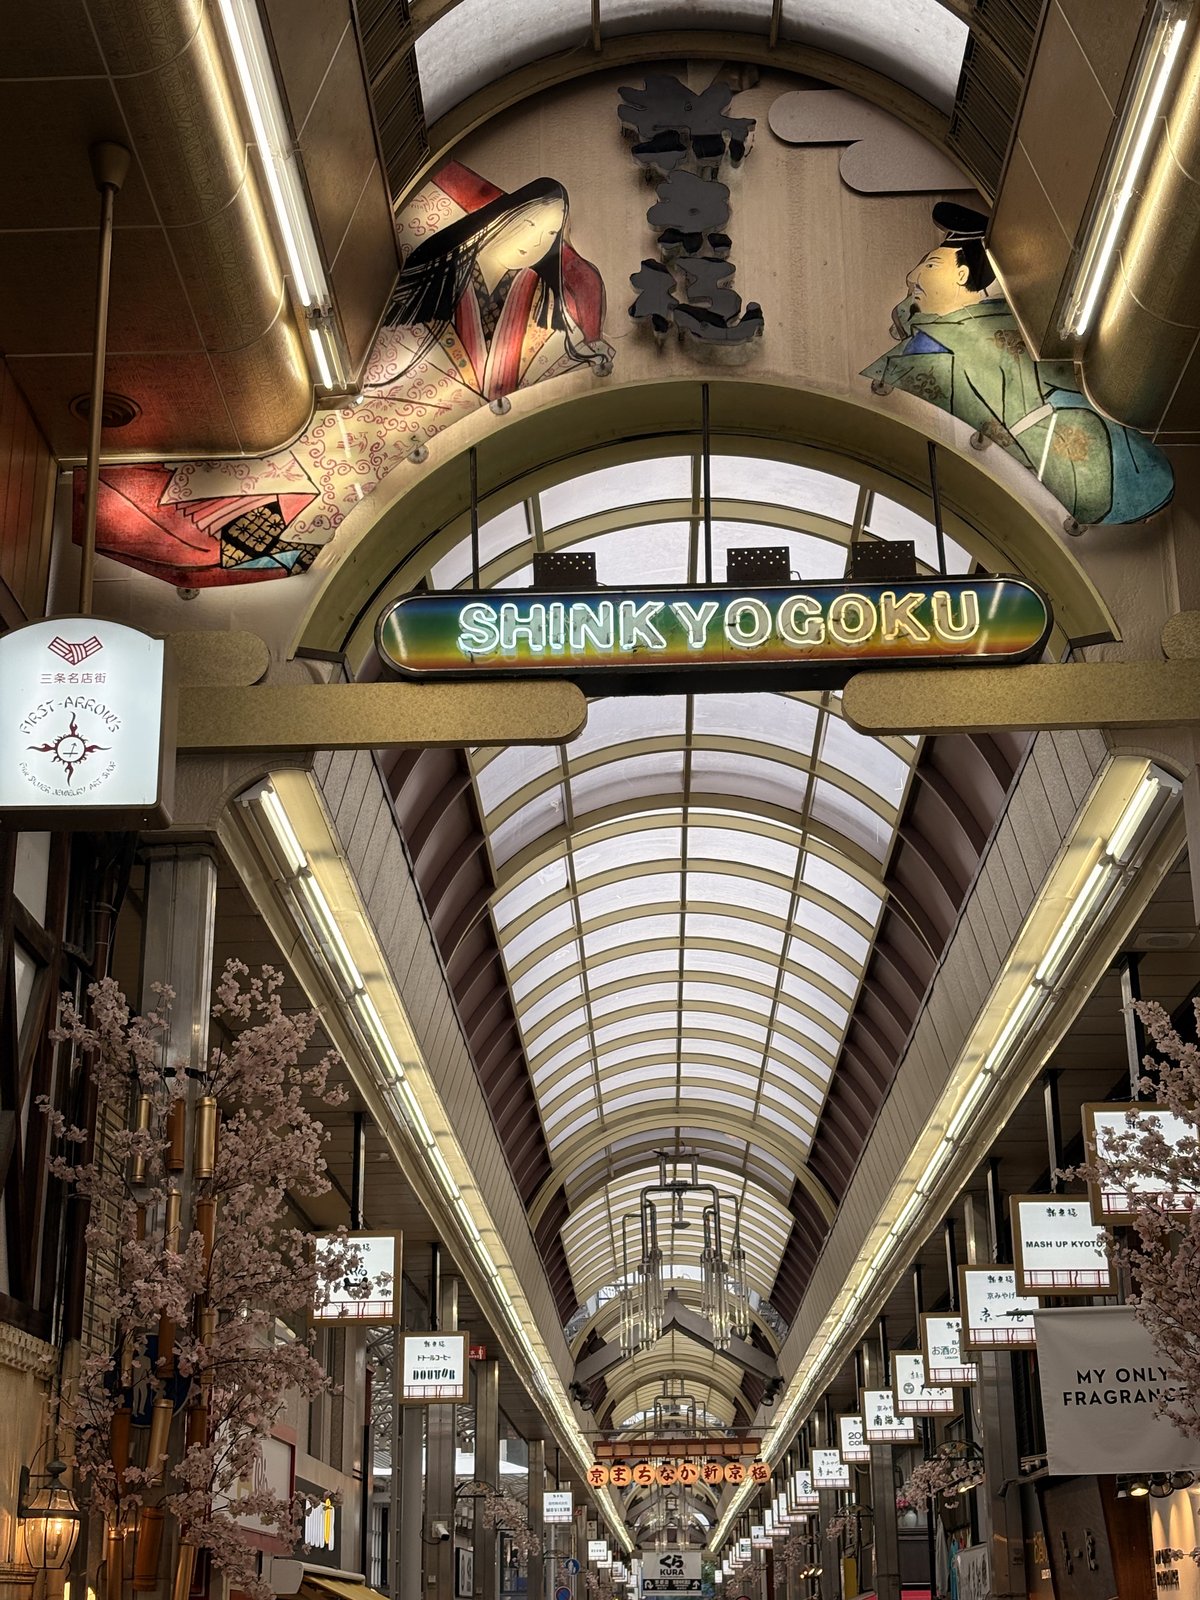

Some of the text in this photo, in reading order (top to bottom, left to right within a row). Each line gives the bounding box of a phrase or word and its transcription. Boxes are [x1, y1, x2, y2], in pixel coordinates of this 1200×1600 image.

[40, 672, 107, 684] 三条名店街
[1025, 1240, 1103, 1248] MASH UP KYOTO
[413, 1368, 456, 1381] DOUTOR
[1076, 1367, 1168, 1384] MY ONLY
[659, 1554, 684, 1568] くら
[660, 1568, 685, 1576] KURA
